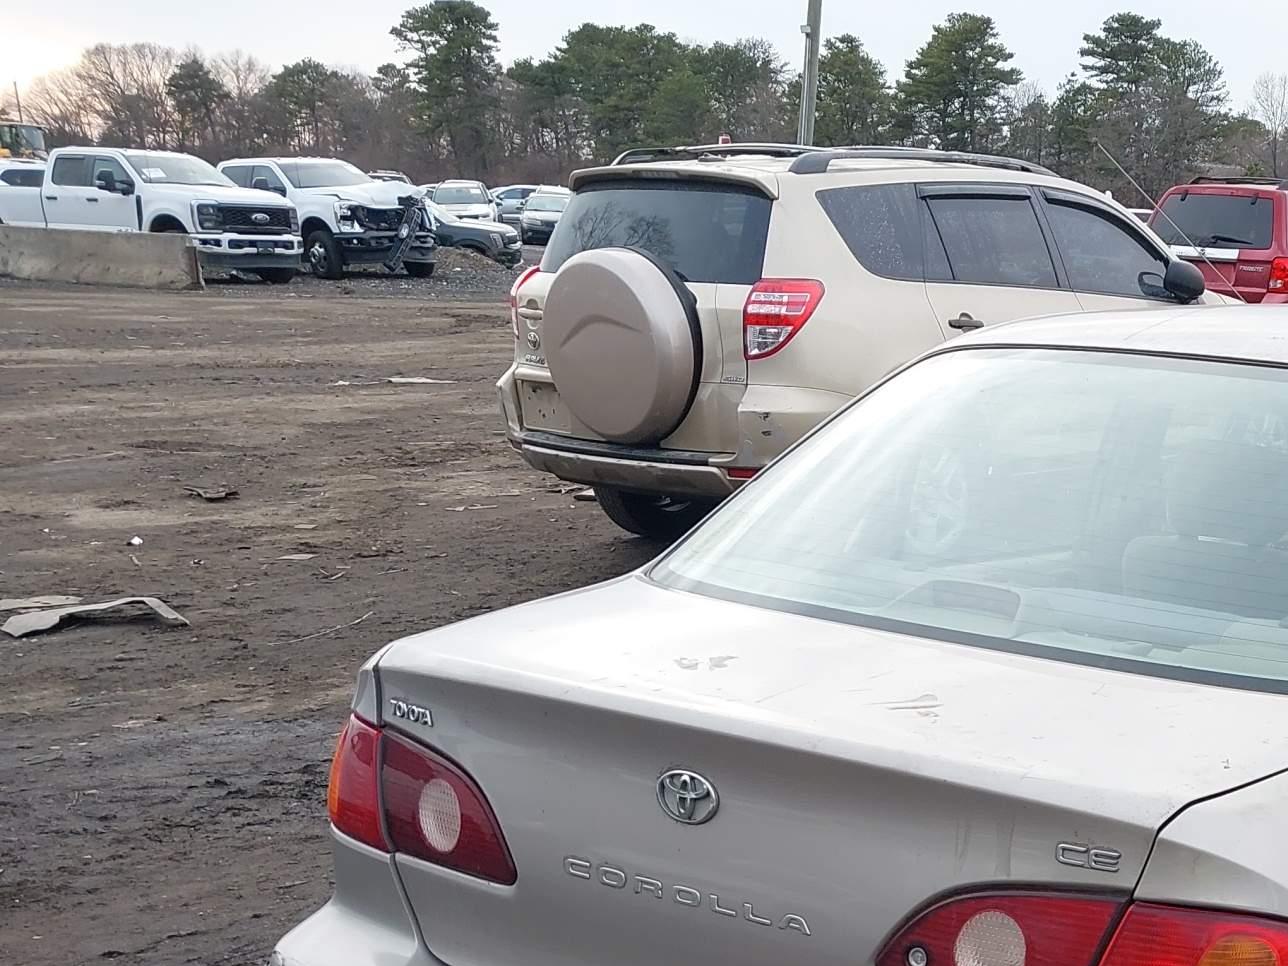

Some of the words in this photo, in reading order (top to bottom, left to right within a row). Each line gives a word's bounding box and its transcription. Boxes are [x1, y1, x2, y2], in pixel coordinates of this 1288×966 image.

[390, 698, 433, 728] TOYOTA
[1056, 842, 1121, 872] CE
[564, 857, 812, 936] COROLLA
